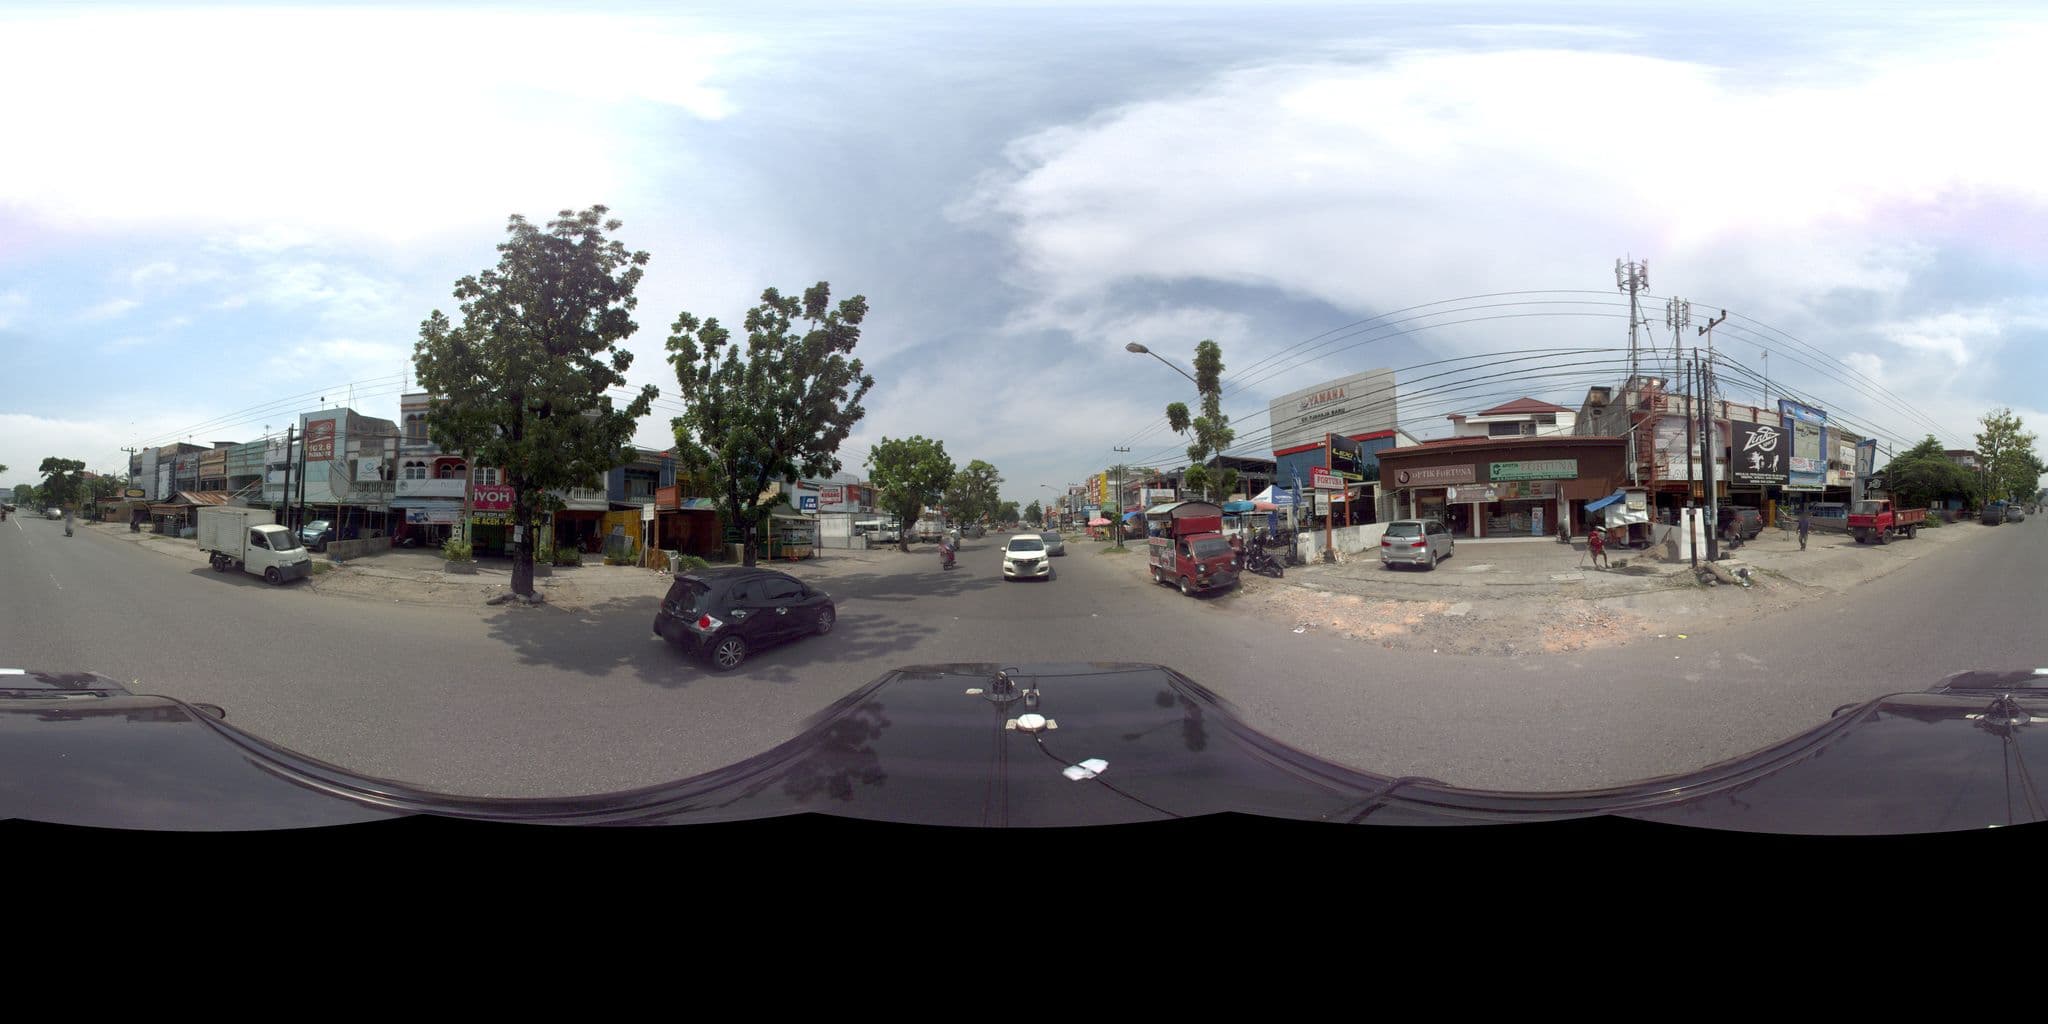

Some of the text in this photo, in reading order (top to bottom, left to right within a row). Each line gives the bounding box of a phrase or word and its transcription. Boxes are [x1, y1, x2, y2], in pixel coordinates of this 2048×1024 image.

[1309, 388, 1345, 406] YAMAHA
[1520, 461, 1574, 472] FORTUNA
[1436, 468, 1472, 477] FORTUNA
[1316, 476, 1343, 486] FORTUNA
